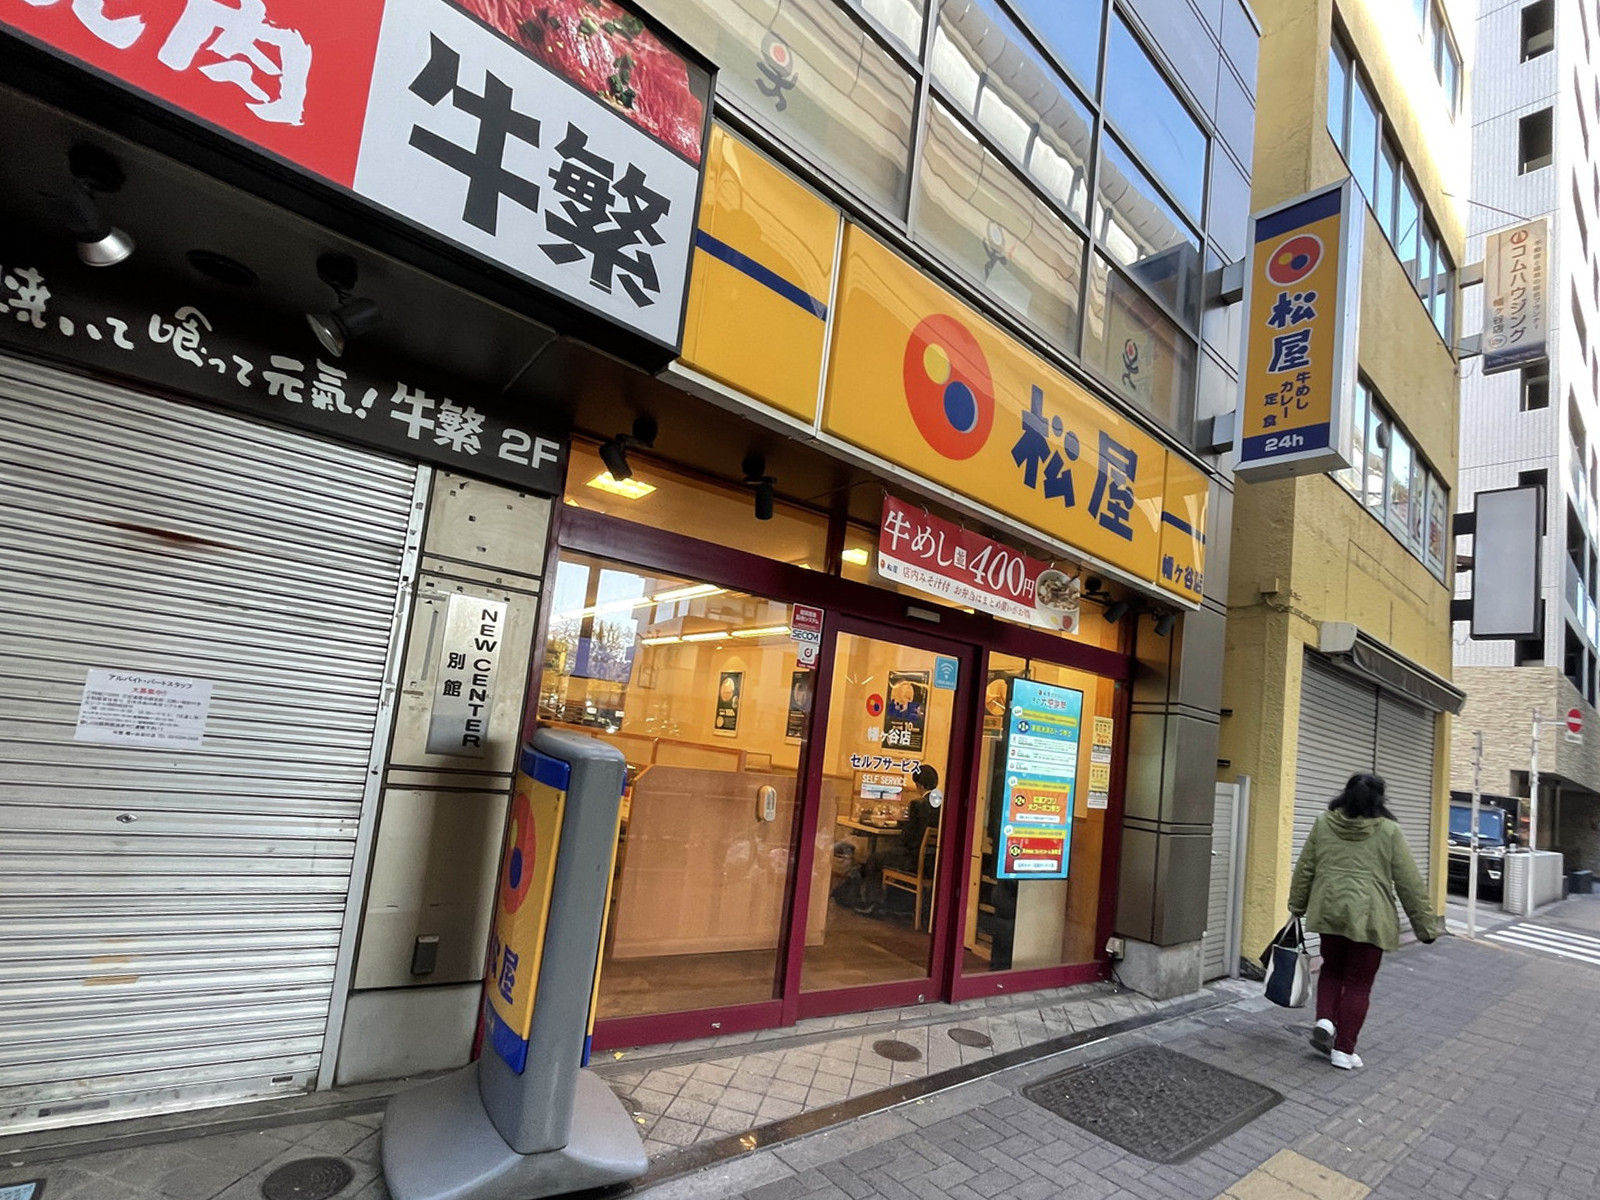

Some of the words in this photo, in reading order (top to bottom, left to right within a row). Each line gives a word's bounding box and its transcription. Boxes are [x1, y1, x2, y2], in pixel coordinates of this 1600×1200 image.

[22, 0, 312, 126] 肉
[408, 30, 671, 308] 牛繁
[1510, 244, 1528, 343] コムハウジング
[1267, 290, 1318, 374] 松屋
[1262, 392, 1279, 428] 定食
[1280, 381, 1294, 418] カレー
[1296, 371, 1311, 410] 牛めし
[390, 381, 486, 455] 牛繁
[498, 428, 560, 469] 2F
[1264, 433, 1304, 452] 24h
[1011, 384, 1138, 542] 松屋
[474, 608, 498, 653] NEW
[792, 629, 819, 642] SECOM
[442, 652, 466, 698] 別館
[462, 658, 492, 748] CENTER
[850, 754, 922, 774] セルフサービス
[862, 774, 880, 785] SELF
[880, 776, 908, 788] SERVICE
